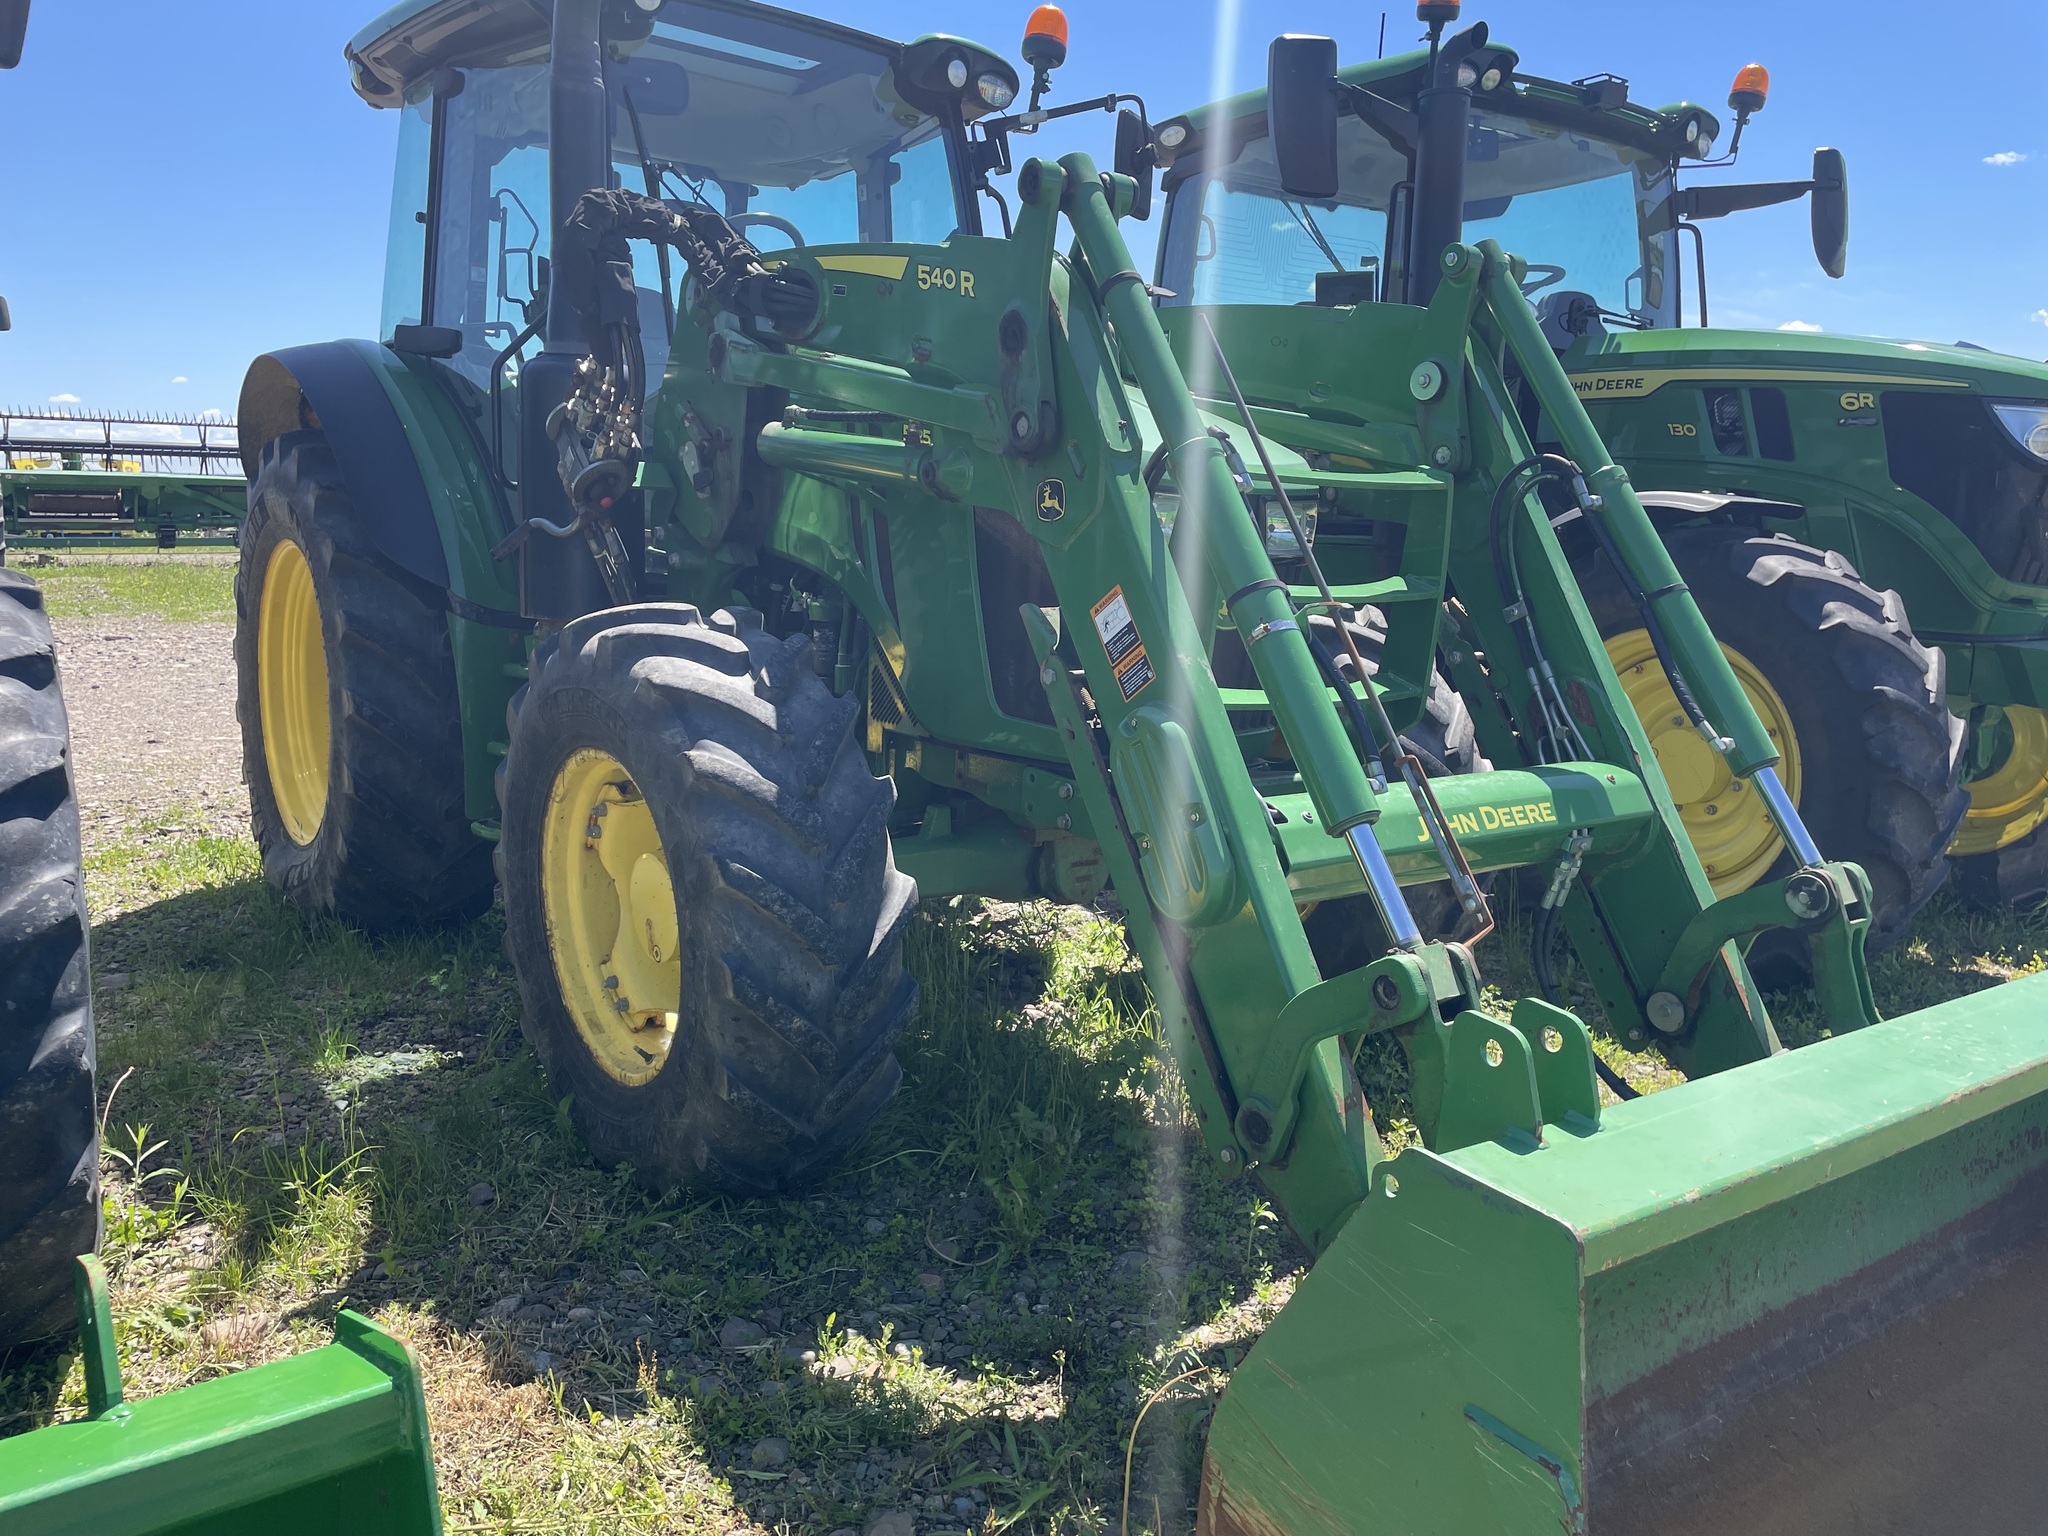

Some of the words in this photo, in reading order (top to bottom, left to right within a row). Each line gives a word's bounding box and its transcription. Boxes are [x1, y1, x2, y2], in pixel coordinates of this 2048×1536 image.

[1596, 378, 1644, 391] DEERE
[1840, 392, 1875, 411] 6R
[1667, 423, 1697, 437] 130
[1098, 589, 1119, 609] WARNING
[1122, 650, 1143, 670] WARNING
[1417, 812, 1480, 842] JHN
[1479, 802, 1556, 830] DEERE
